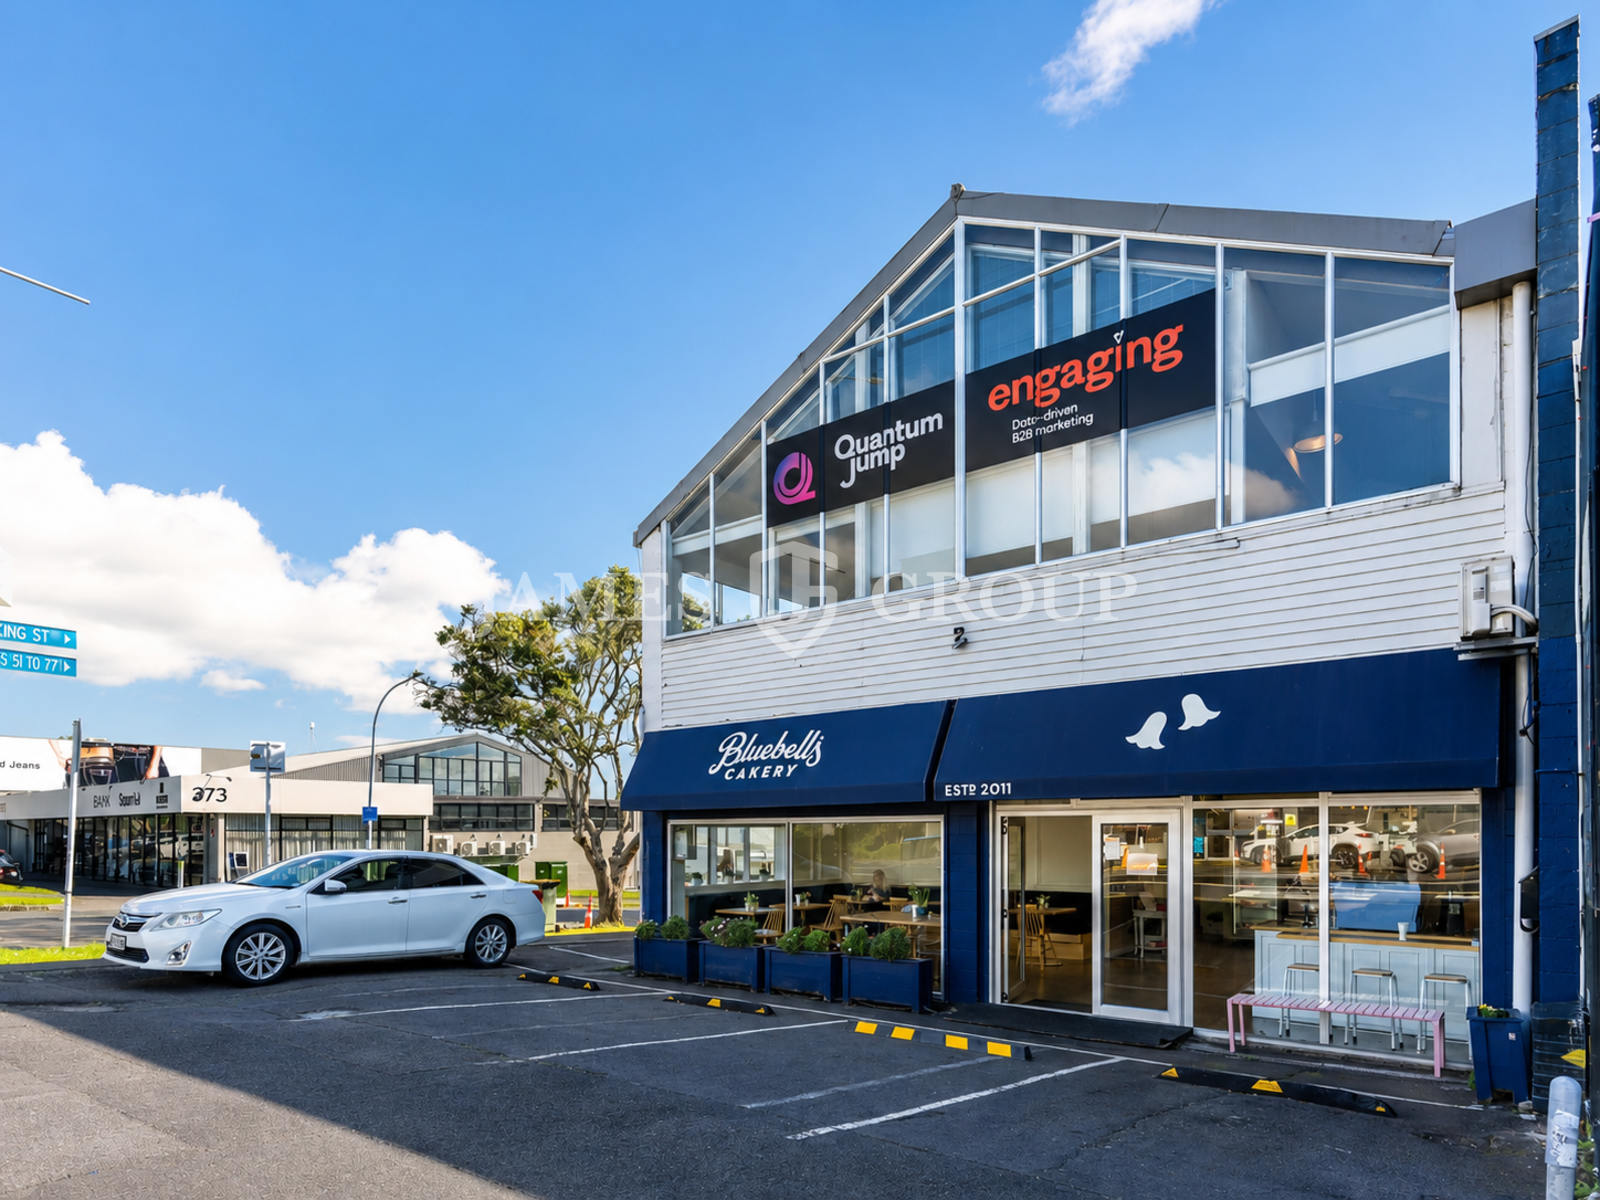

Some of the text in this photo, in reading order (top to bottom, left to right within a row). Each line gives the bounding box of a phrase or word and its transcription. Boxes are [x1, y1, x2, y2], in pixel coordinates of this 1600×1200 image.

[988, 324, 1184, 411] engaging
[1012, 404, 1078, 430] Data-driven
[1012, 413, 1094, 443] B2B marketing
[834, 412, 943, 461] Quantum
[840, 443, 906, 488] jump
[33, 628, 50, 643] ST
[952, 627, 968, 649] 2
[13, 654, 22, 668] 51
[26, 656, 40, 670] TO
[45, 658, 58, 672] 77
[9, 760, 41, 770] Jeans
[724, 764, 798, 780] CAKERY
[981, 782, 1012, 796] 2011
